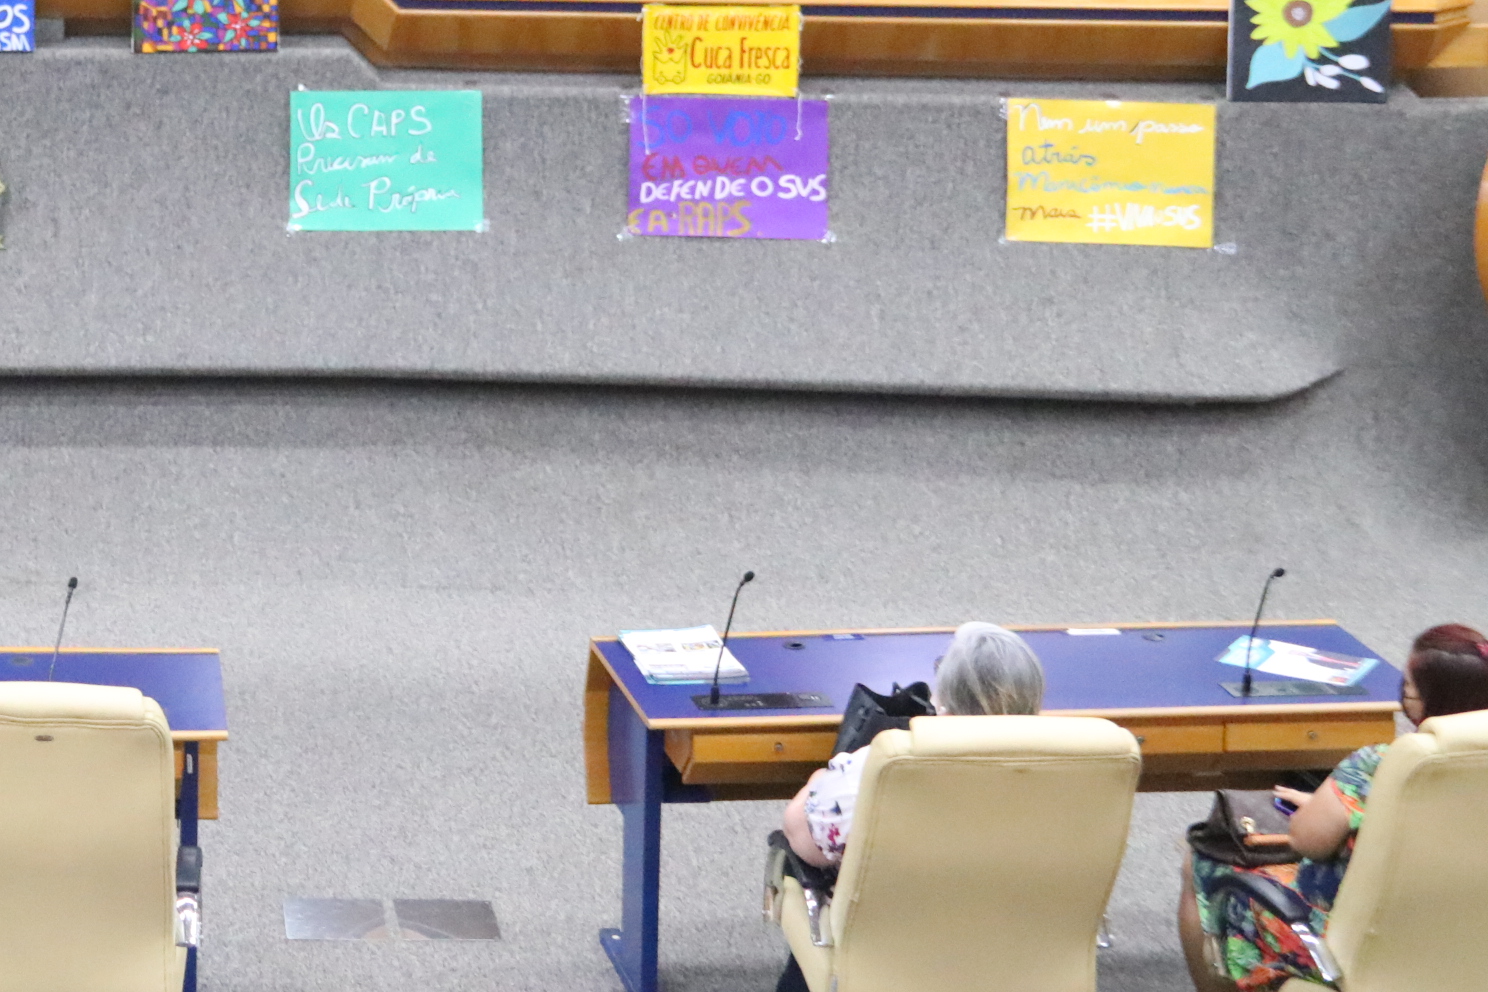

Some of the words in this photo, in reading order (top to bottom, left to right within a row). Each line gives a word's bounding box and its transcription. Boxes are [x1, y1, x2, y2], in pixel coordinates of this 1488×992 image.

[690, 36, 732, 69] Cuca
[739, 37, 791, 70] Fresca
[347, 103, 433, 138] CAPS
[641, 152, 686, 181] EM
[640, 175, 746, 203] DEFENDE
[750, 176, 774, 198] O
[777, 174, 827, 202] SUS
[627, 208, 646, 234] E
[647, 209, 669, 233] A
